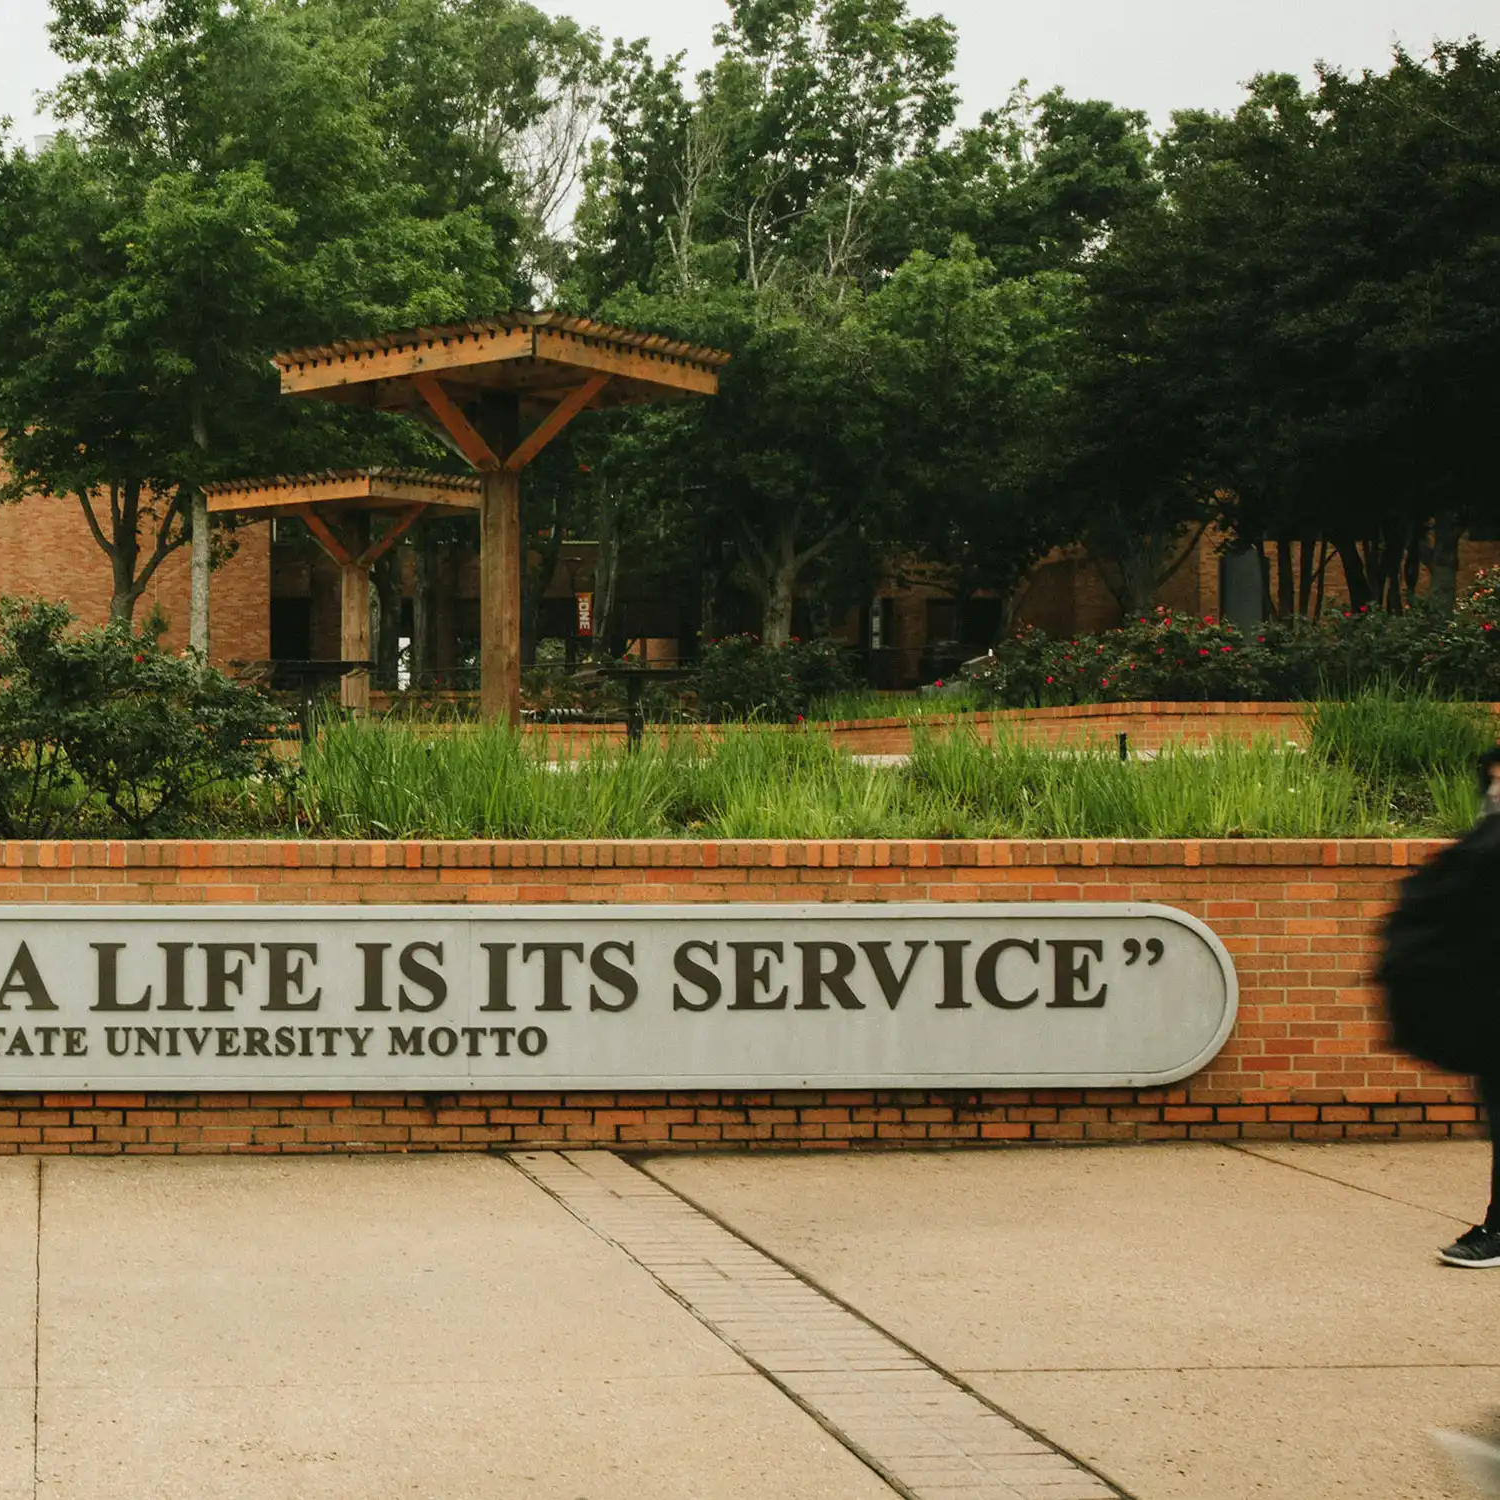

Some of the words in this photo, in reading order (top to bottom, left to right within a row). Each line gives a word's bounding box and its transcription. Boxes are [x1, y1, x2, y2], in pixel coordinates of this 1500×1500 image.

[89, 942, 322, 1012] LIFE
[354, 941, 448, 1012] IS
[479, 940, 639, 1012] ITS
[104, 1026, 374, 1057] UNIVERSITY
[388, 1026, 548, 1057] MOTTO
